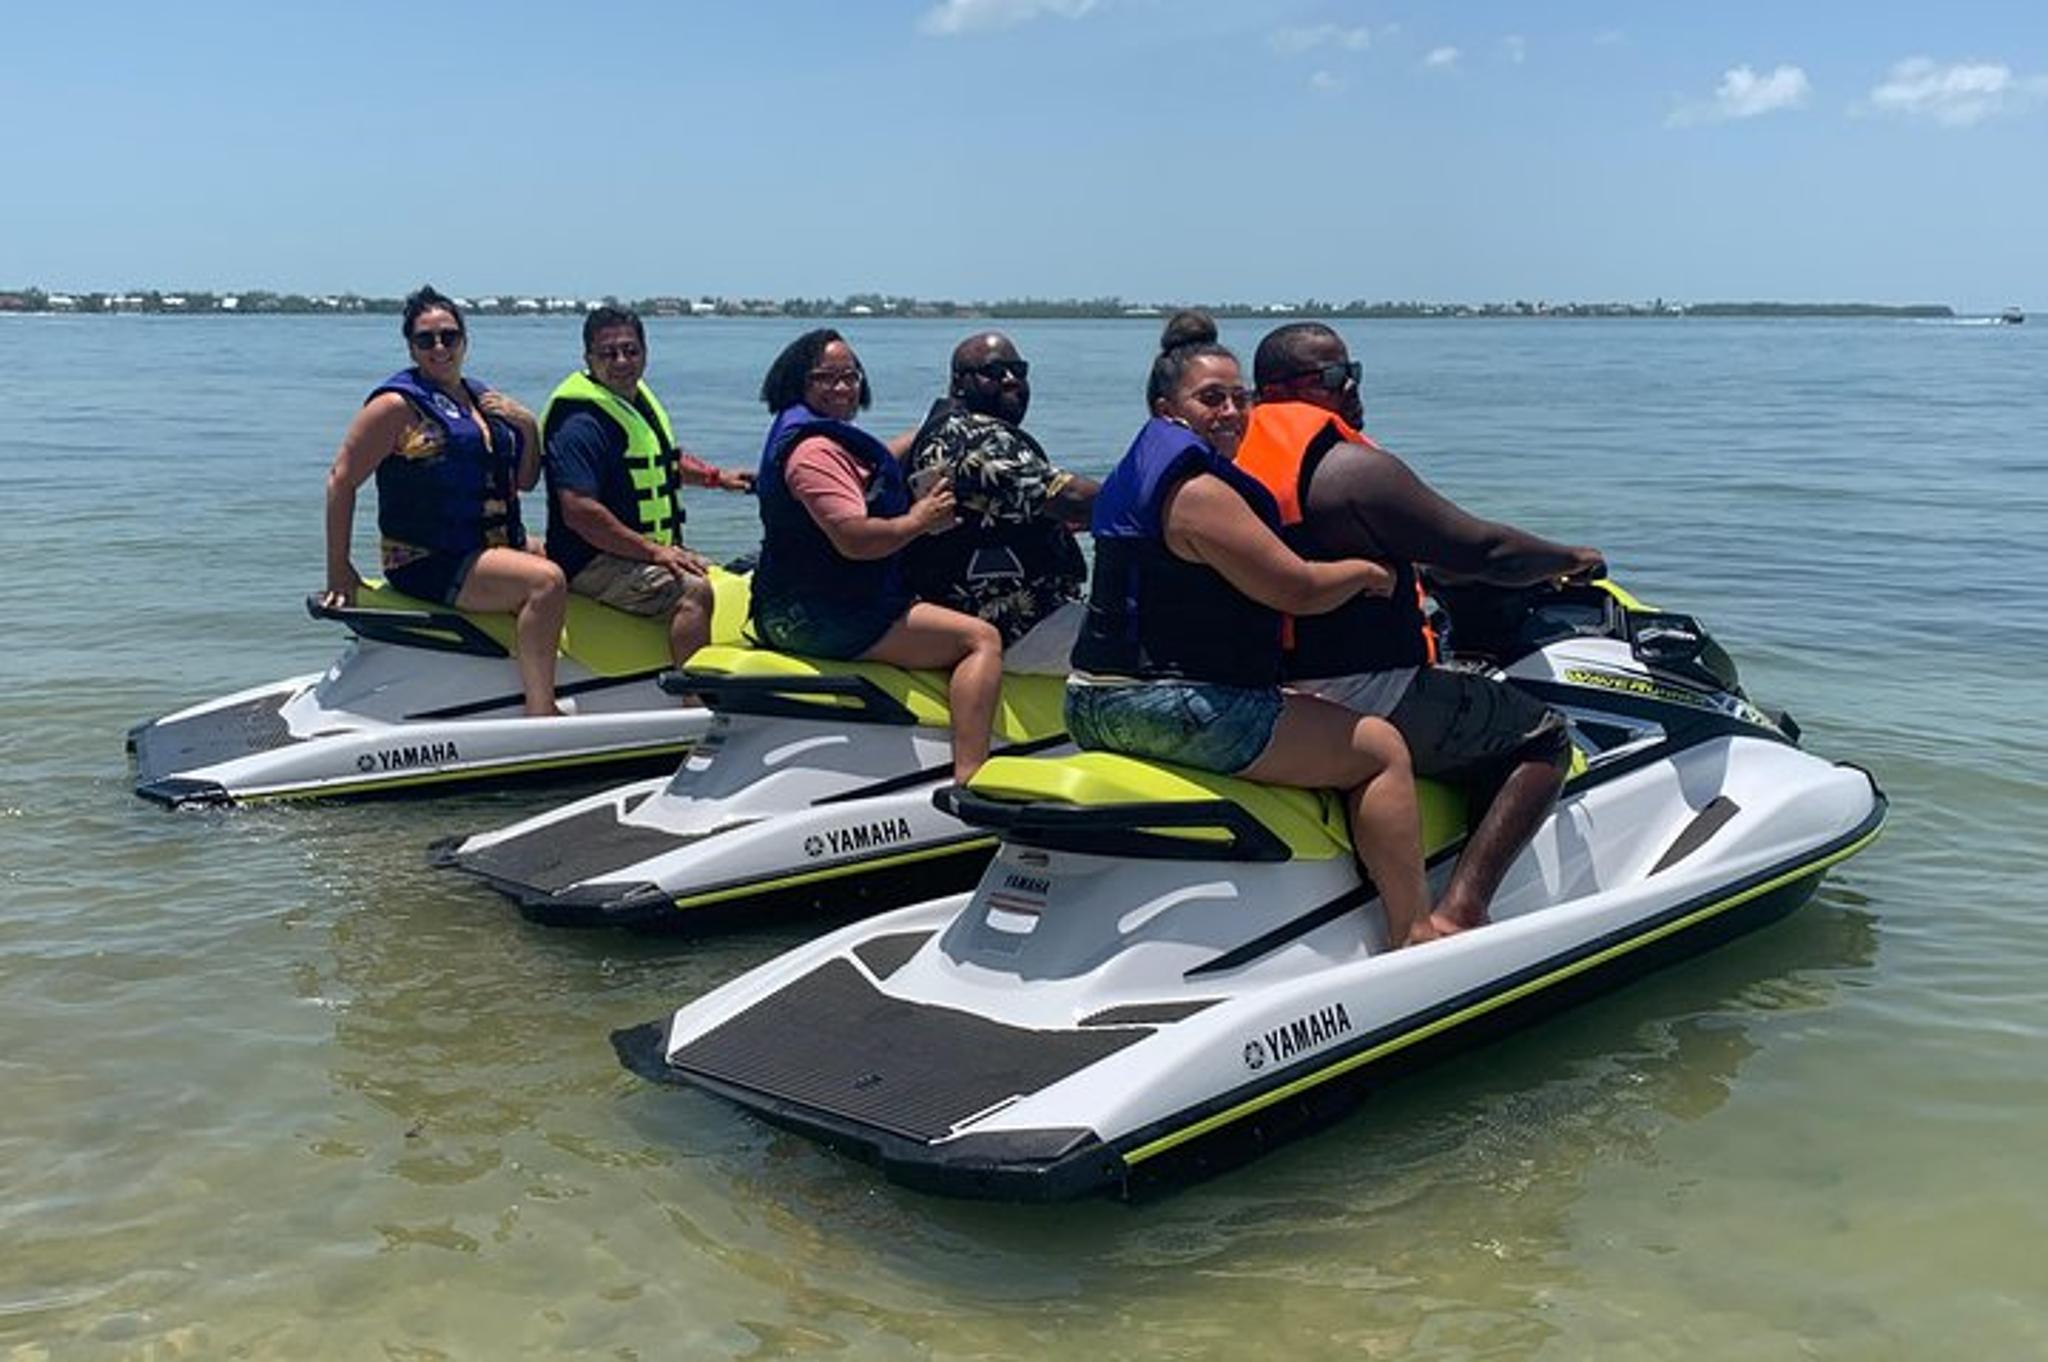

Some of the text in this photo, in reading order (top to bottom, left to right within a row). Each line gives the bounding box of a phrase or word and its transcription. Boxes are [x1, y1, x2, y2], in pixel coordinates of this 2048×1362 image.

[378, 741, 458, 769] YAMAHA
[826, 818, 911, 853] YAMAHA
[1265, 1003, 1351, 1061] YAMAHA
